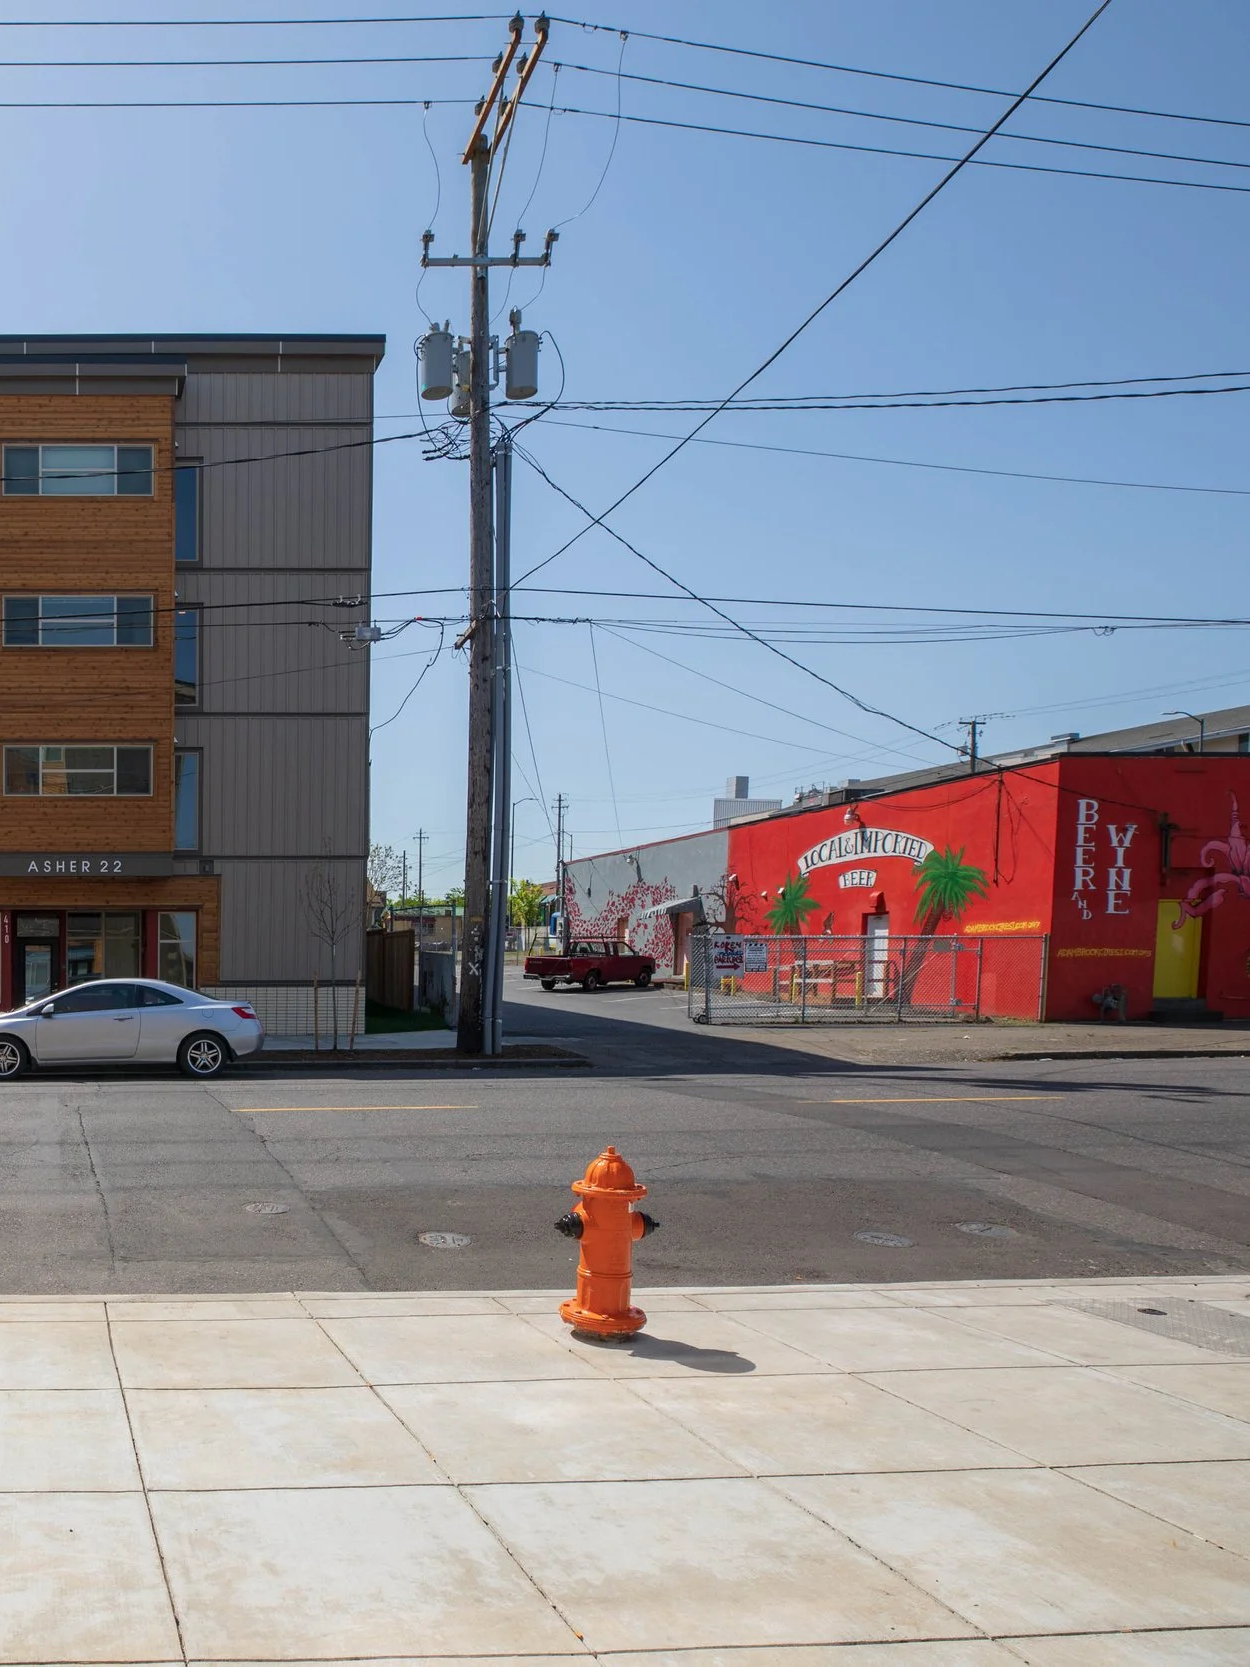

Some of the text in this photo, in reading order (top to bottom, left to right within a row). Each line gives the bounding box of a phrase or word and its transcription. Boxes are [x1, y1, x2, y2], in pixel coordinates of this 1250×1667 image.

[1074, 799, 1099, 891] BEER
[27, 860, 122, 873] ASHER 22
[843, 870, 873, 887] BEER
[1105, 823, 1138, 914] WINE
[1071, 892, 1092, 920] AND
